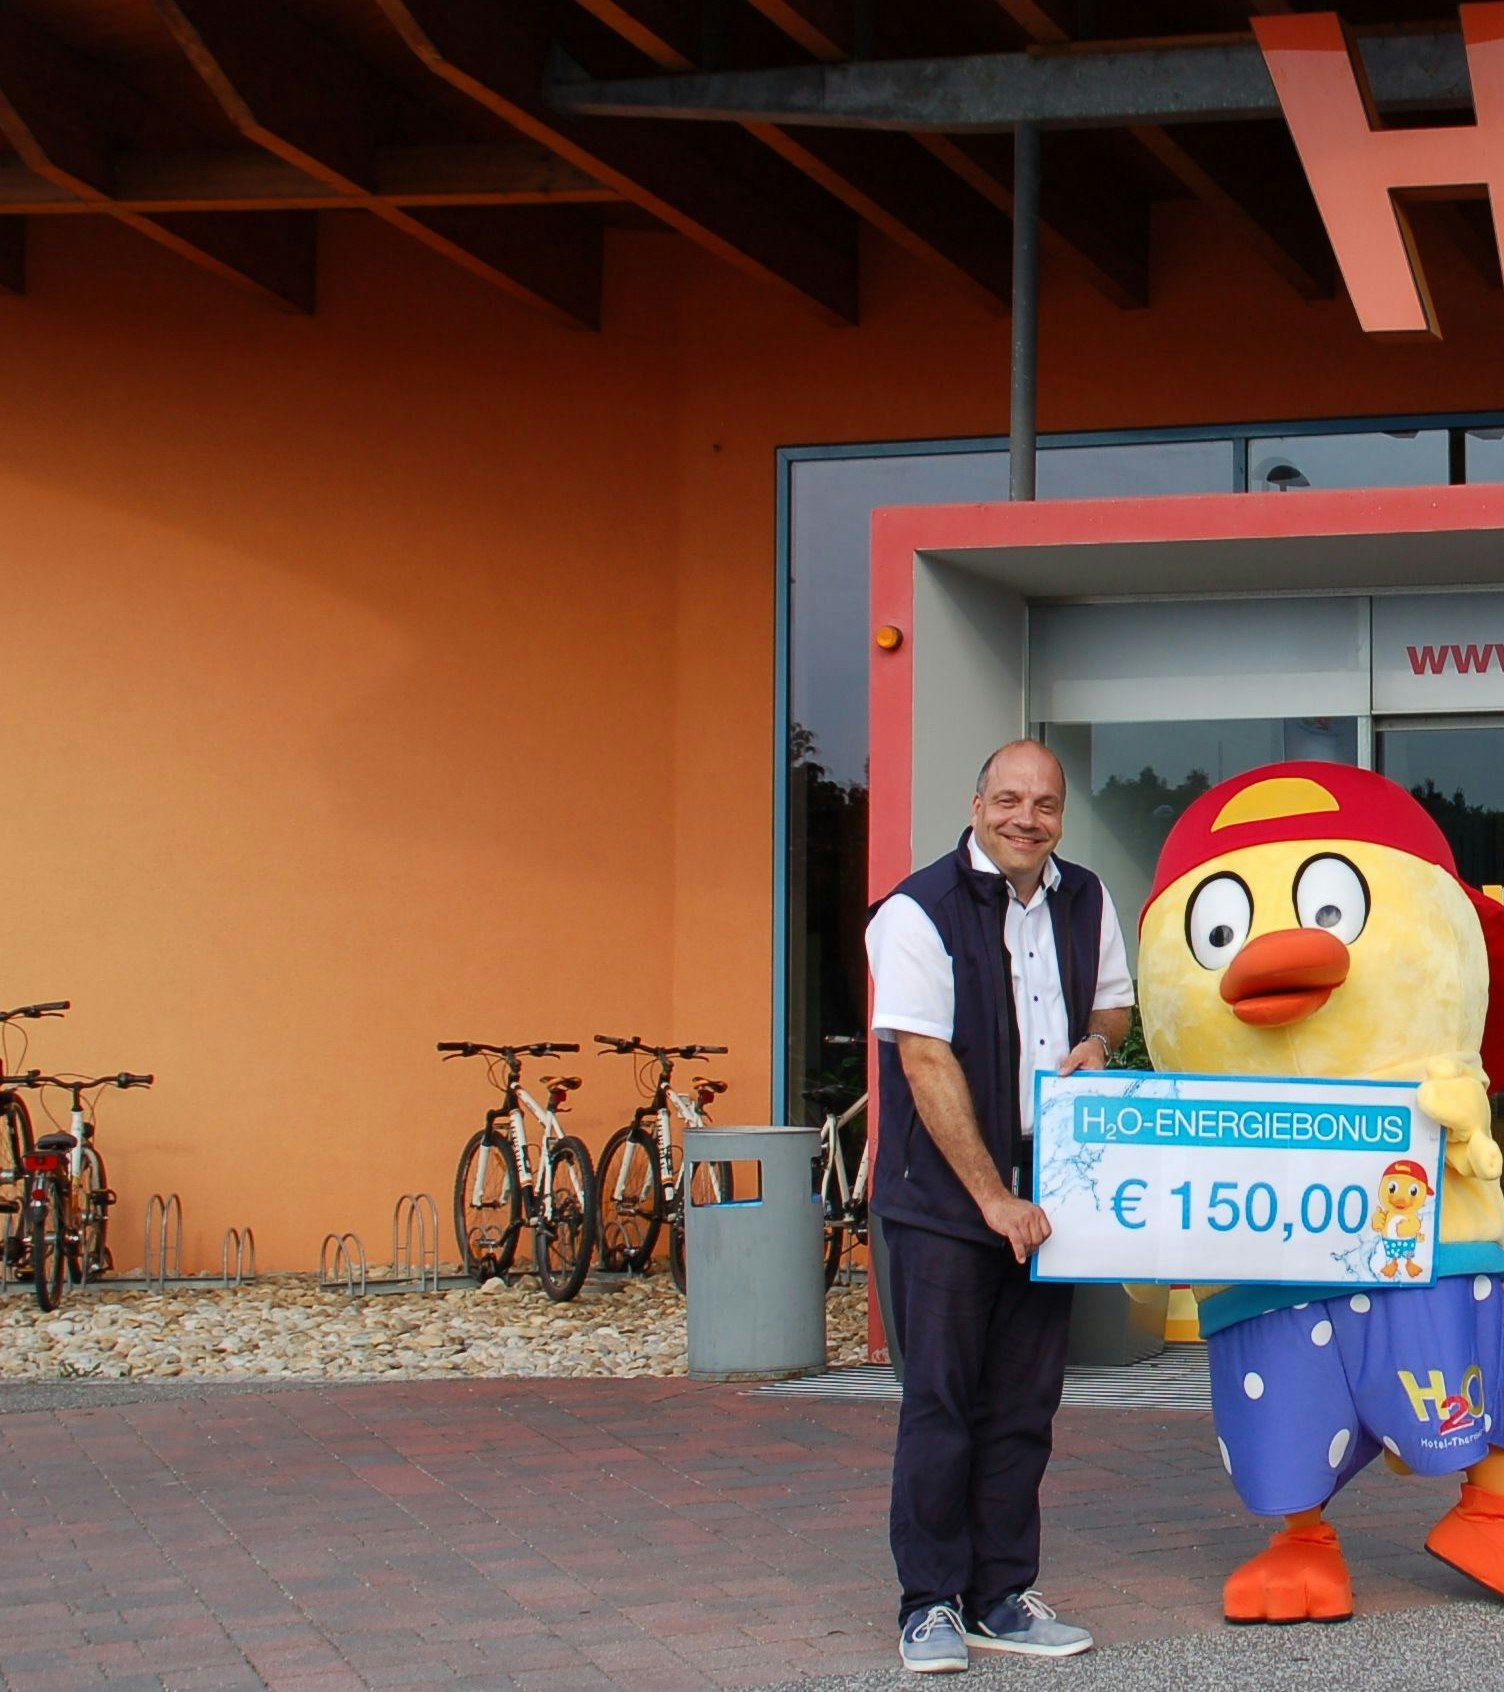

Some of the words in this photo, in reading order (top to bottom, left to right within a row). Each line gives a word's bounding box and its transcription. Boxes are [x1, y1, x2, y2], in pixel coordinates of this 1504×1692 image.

[1081, 1107, 1404, 1144] H2O-ENERGIEBONUS
[1110, 1178, 1148, 1230] €
[1169, 1181, 1368, 1242] 150,00
[1397, 1365, 1485, 1436] H2O
